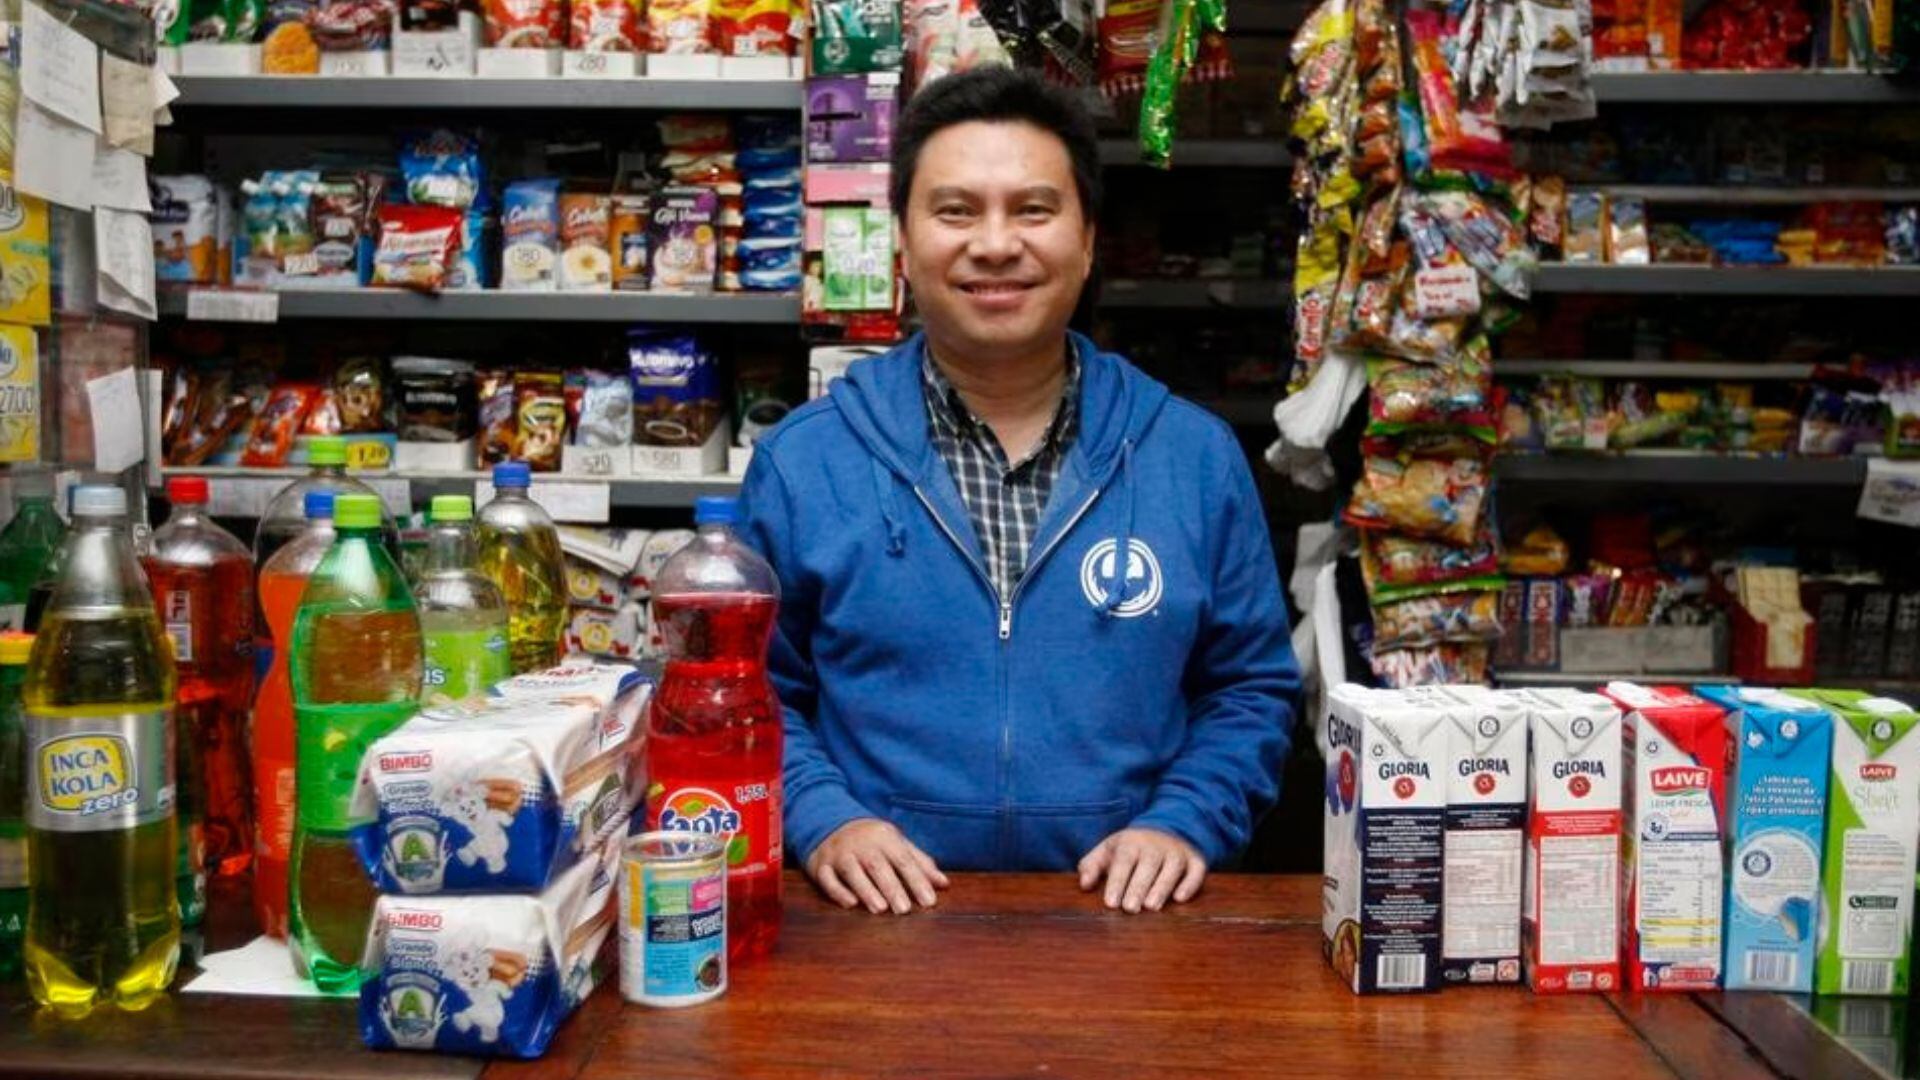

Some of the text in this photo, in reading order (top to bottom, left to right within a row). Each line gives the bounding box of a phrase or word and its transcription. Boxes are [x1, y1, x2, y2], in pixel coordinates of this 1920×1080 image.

[51, 750, 109, 773] INCA
[380, 755, 433, 772] BIMBO
[1378, 761, 1431, 781] GLORIA
[1459, 759, 1511, 777] GLORIA
[1552, 760, 1606, 779] GLORIA
[1654, 772, 1705, 787] LAIVE
[1862, 766, 1894, 777] LAIVE
[52, 772, 117, 797] KOLA
[81, 787, 139, 816] zero
[659, 804, 741, 837] Fanta
